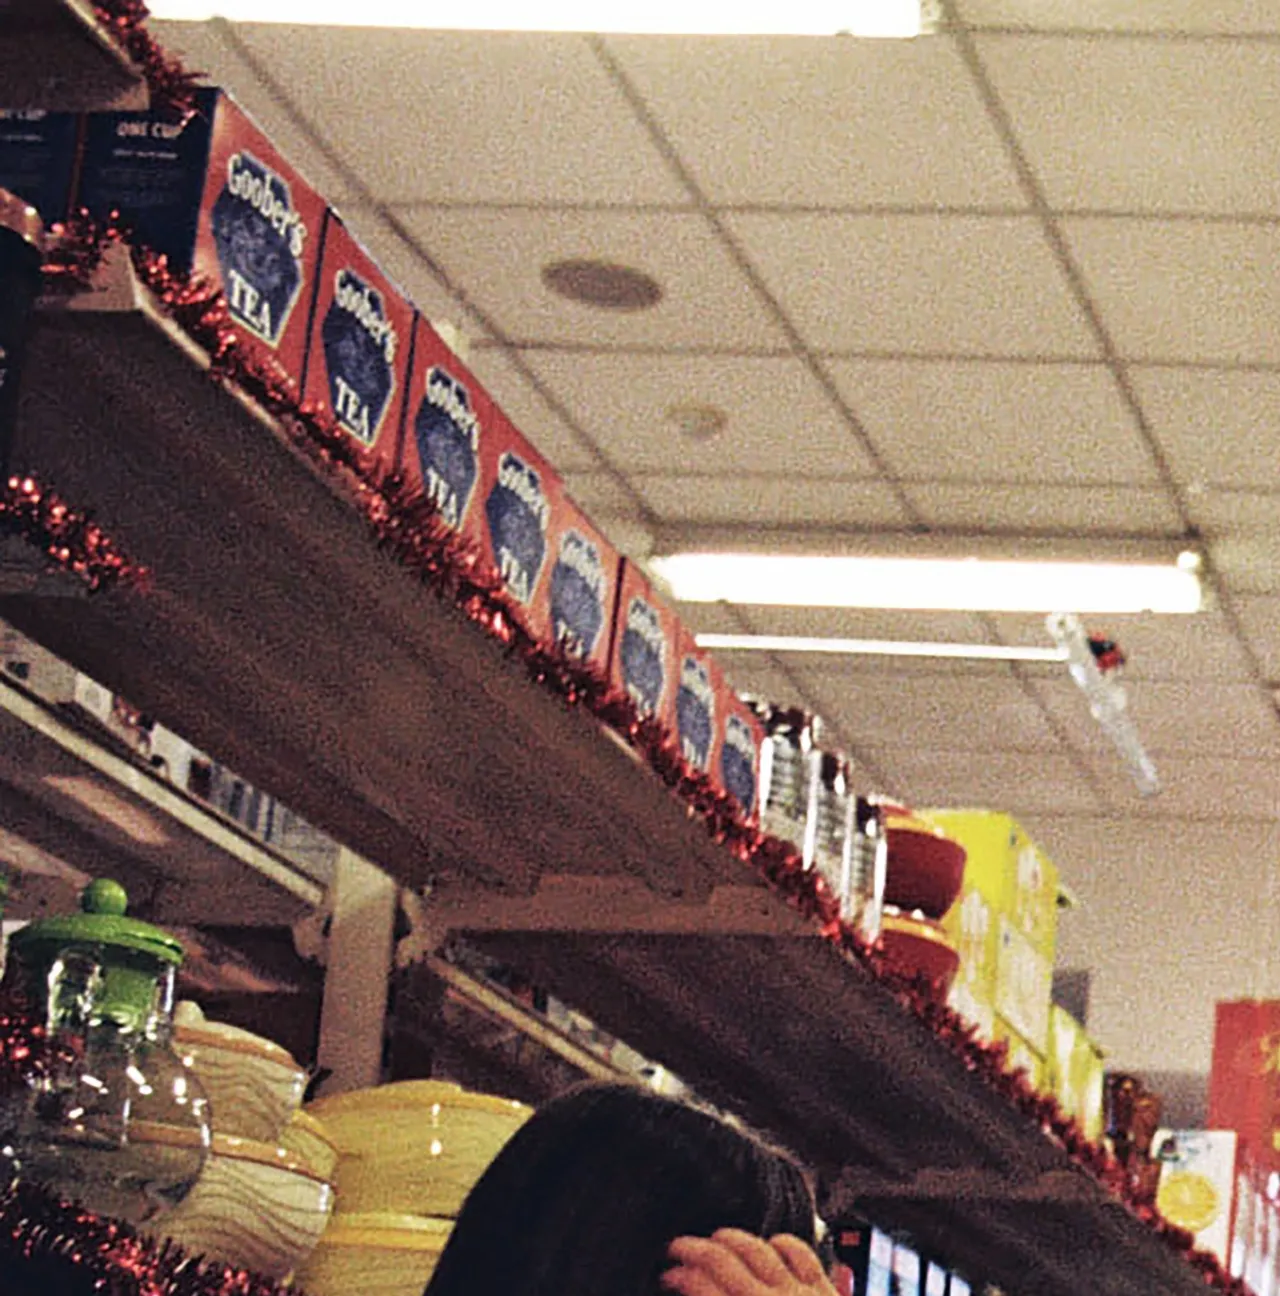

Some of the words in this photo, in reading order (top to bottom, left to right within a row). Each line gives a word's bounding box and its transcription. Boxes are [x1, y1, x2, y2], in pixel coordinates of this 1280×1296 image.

[117, 121, 148, 137] ONE
[229, 268, 273, 338] TEA
[335, 376, 370, 441] TEA
